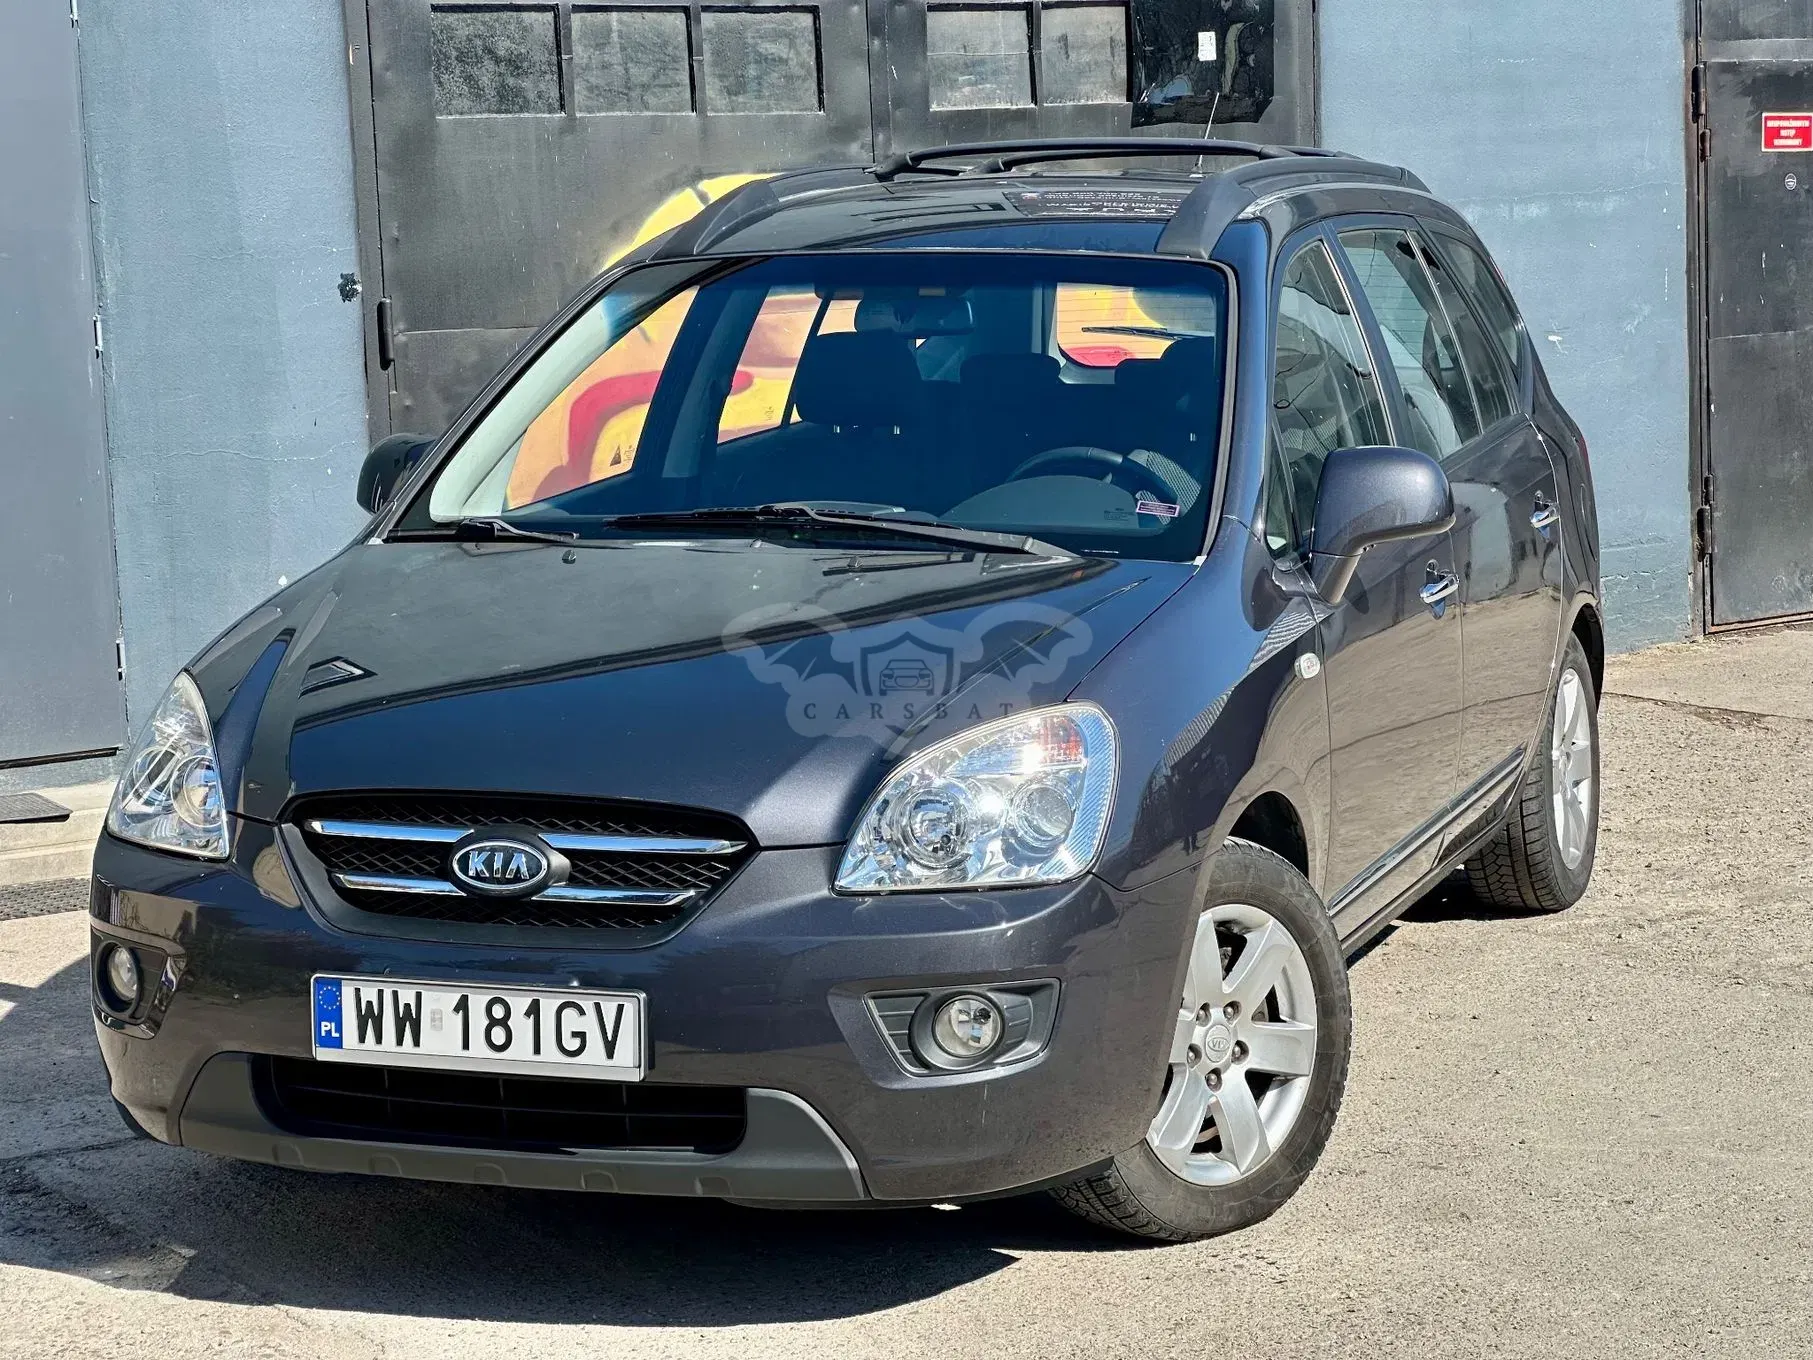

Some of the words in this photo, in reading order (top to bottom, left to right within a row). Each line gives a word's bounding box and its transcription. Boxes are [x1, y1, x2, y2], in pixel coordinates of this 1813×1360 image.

[468, 850, 530, 880] KIA
[320, 1021, 340, 1038] PL
[354, 987, 423, 1048] WW
[452, 993, 626, 1060] 181GV
